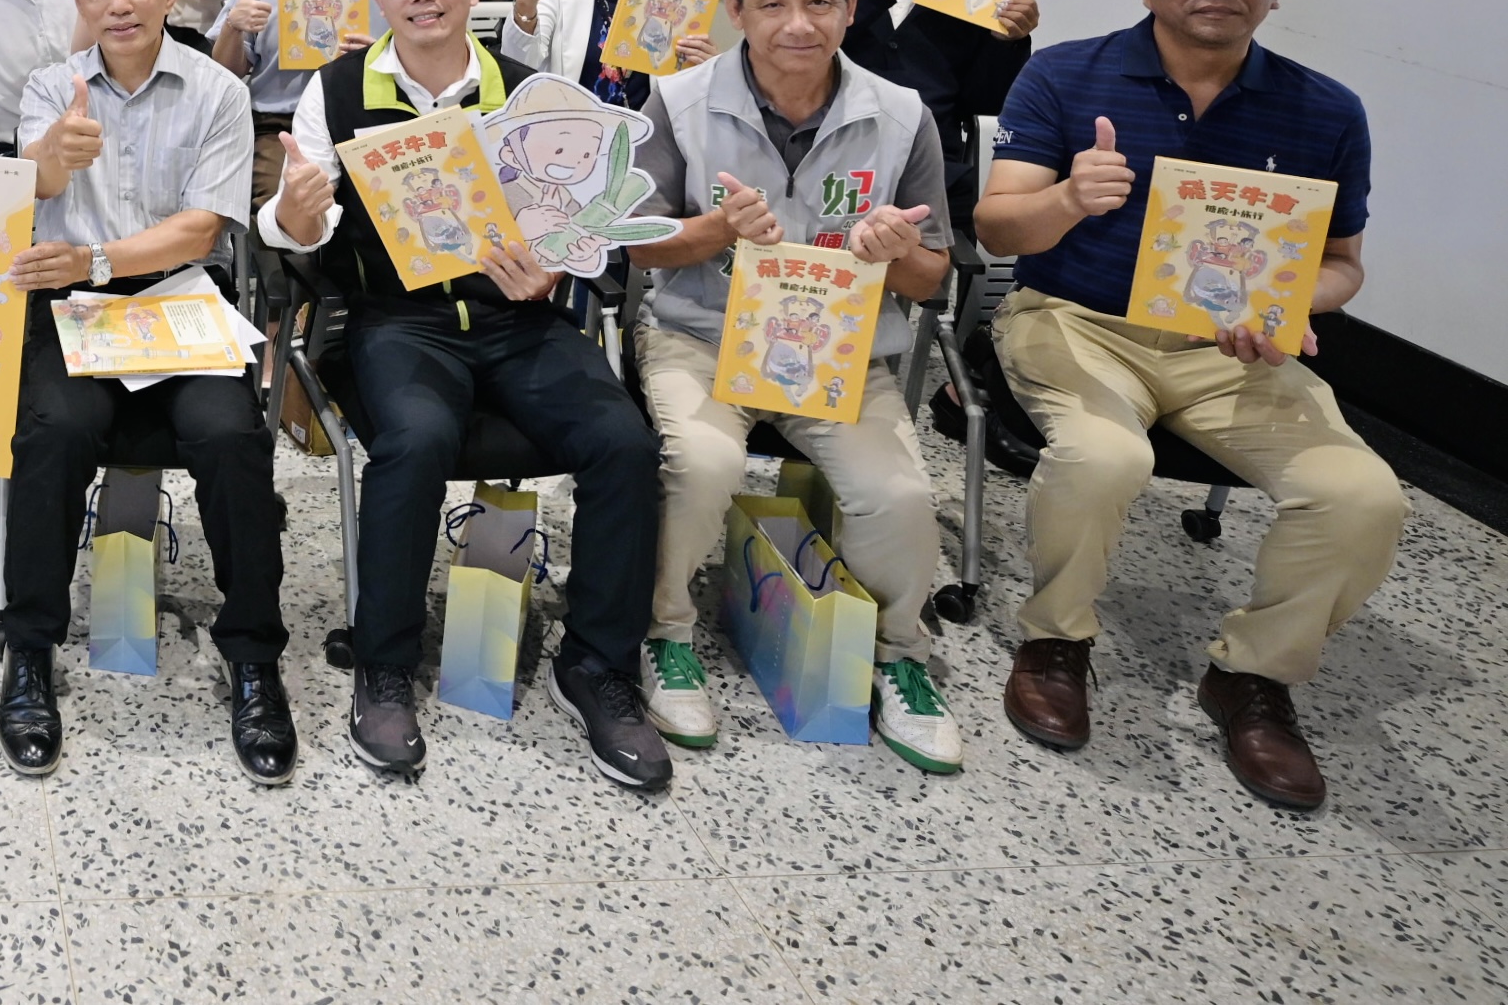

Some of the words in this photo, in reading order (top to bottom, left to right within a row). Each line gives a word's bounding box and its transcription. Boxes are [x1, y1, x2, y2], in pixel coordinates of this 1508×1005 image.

[363, 131, 448, 171] 飛天牛車
[1177, 179, 1300, 215] 飛天牛車
[1205, 204, 1264, 220] 糖廠小旅行
[756, 257, 857, 290] 飛天牛車
